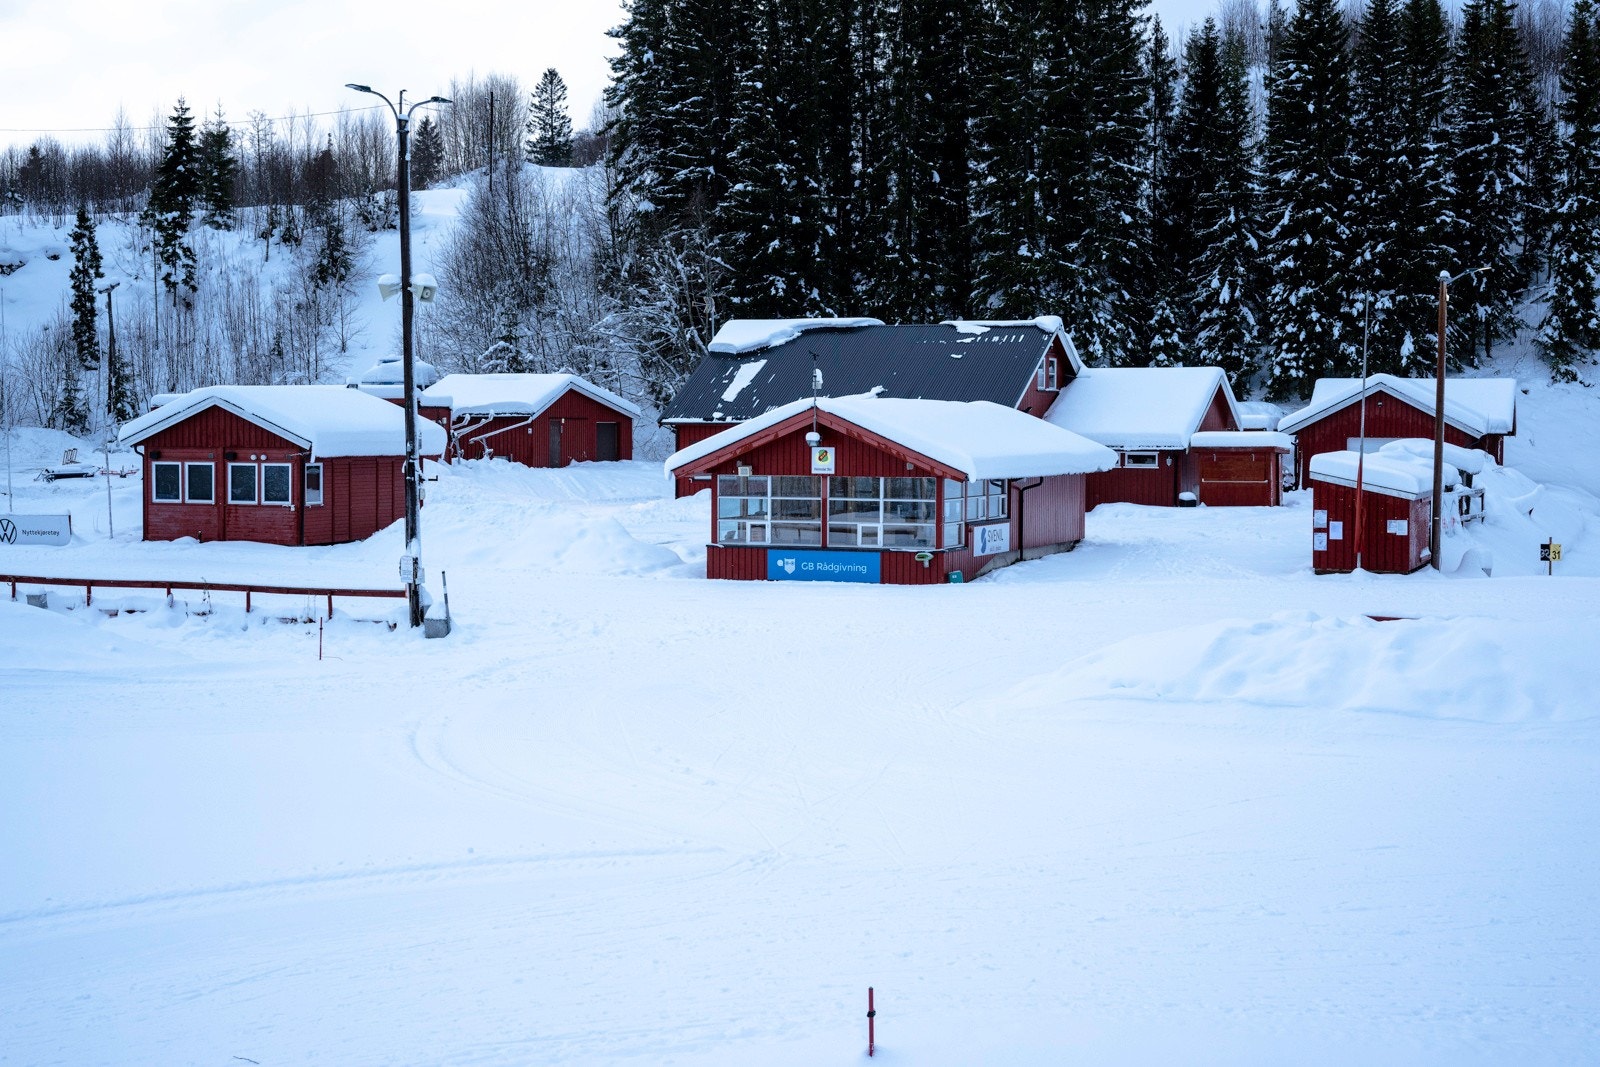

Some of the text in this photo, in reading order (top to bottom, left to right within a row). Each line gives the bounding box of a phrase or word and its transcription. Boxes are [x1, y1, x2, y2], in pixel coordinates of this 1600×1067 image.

[1552, 551, 1560, 560] 31
[801, 562, 867, 574] GB Rådgivning
